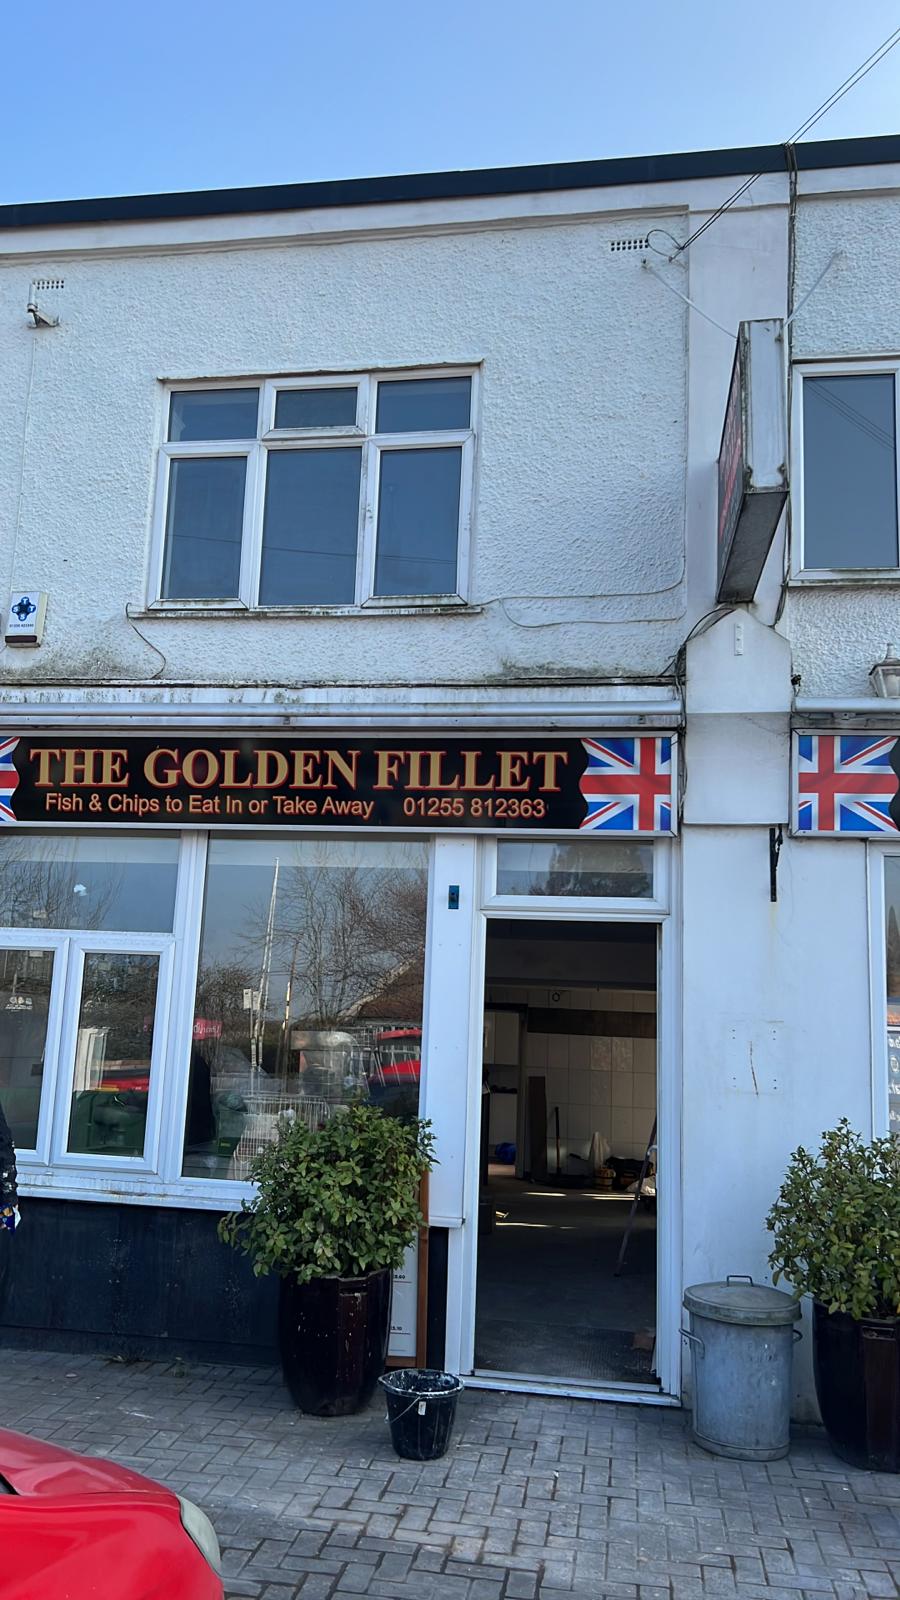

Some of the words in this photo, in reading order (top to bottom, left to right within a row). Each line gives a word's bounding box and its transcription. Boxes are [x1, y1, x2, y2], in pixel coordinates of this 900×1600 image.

[29, 748, 130, 788] THE
[143, 748, 361, 790] GOLDEN
[372, 750, 568, 792] FILLET
[45, 792, 83, 812] Fish
[88, 793, 103, 812] &
[107, 793, 160, 817] Chips
[165, 795, 183, 813] to
[188, 795, 221, 814] Eat
[226, 795, 243, 814] In
[248, 799, 269, 814] or
[272, 796, 318, 815] Take
[321, 797, 375, 820] Away
[403, 797, 465, 817] 01255
[470, 798, 546, 818] 812363
